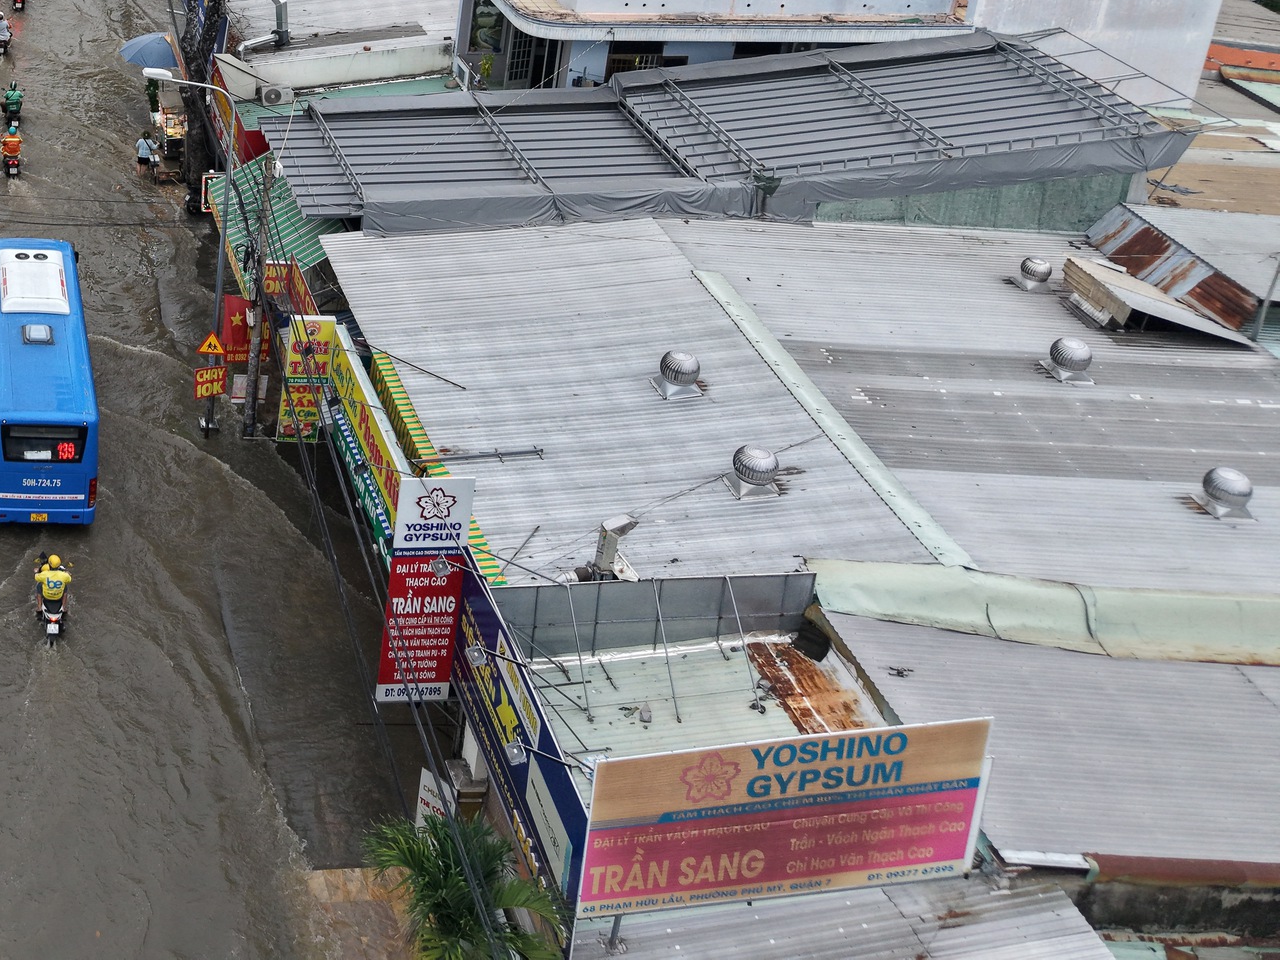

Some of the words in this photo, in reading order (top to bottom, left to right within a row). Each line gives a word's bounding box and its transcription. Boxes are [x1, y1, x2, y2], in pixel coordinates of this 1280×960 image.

[405, 522, 462, 532] YOSHINO
[403, 532, 461, 542] GYPSUM
[396, 564, 409, 576] ĐẠI
[410, 561, 418, 573] LÝ
[419, 559, 434, 573] TRẦ
[46, 576, 63, 590] be
[405, 577, 430, 589] THẠCH
[430, 576, 447, 586] CAO
[392, 589, 421, 615] TRẦN
[423, 595, 456, 613] SANG
[427, 627, 441, 637] THẠCH
[441, 627, 451, 635] CAO
[409, 637, 420, 647] VĂN
[420, 638, 438, 648] THẠCH
[437, 638, 449, 646] CAO
[415, 649, 431, 657] TRANH
[431, 649, 438, 657] PU
[440, 649, 447, 657] PS
[417, 658, 437, 669] TƯỜNG
[419, 669, 436, 679] SÓNG
[384, 688, 396, 697] ĐT:
[420, 686, 442, 697] 67895
[751, 732, 908, 770] YOSHINO
[746, 760, 904, 798] GYPSUM
[792, 812, 835, 830] Chuyên
[838, 812, 867, 825] Cung
[870, 807, 894, 821] Cấp
[916, 803, 931, 815] Thi
[934, 801, 964, 815] Công
[593, 837, 613, 853] ĐẠI
[616, 831, 631, 846] LÝ
[744, 822, 771, 832] CAO
[790, 833, 816, 851] Trần
[826, 830, 858, 846] Vách
[861, 826, 895, 843] Ngăn
[899, 823, 935, 839] Thạch
[939, 820, 966, 833] Cao
[786, 857, 807, 874] Chỉ
[810, 856, 836, 870] Hoa
[839, 852, 864, 867] Văn
[867, 849, 905, 867] Thạch
[907, 846, 934, 858] Cao
[589, 846, 669, 895] TRẦN
[678, 849, 765, 887] SANG
[867, 872, 883, 881] ĐT:
[886, 868, 919, 879] 09377
[921, 864, 955, 876] 67895
[582, 903, 595, 913] 68
[599, 900, 632, 913] PHẠM
[635, 895, 659, 908] HỮU
[689, 888, 738, 902] PHƯỜNG
[740, 884, 763, 897] PHÚ
[789, 878, 822, 891] QUẬN
[824, 878, 832, 886] 7
